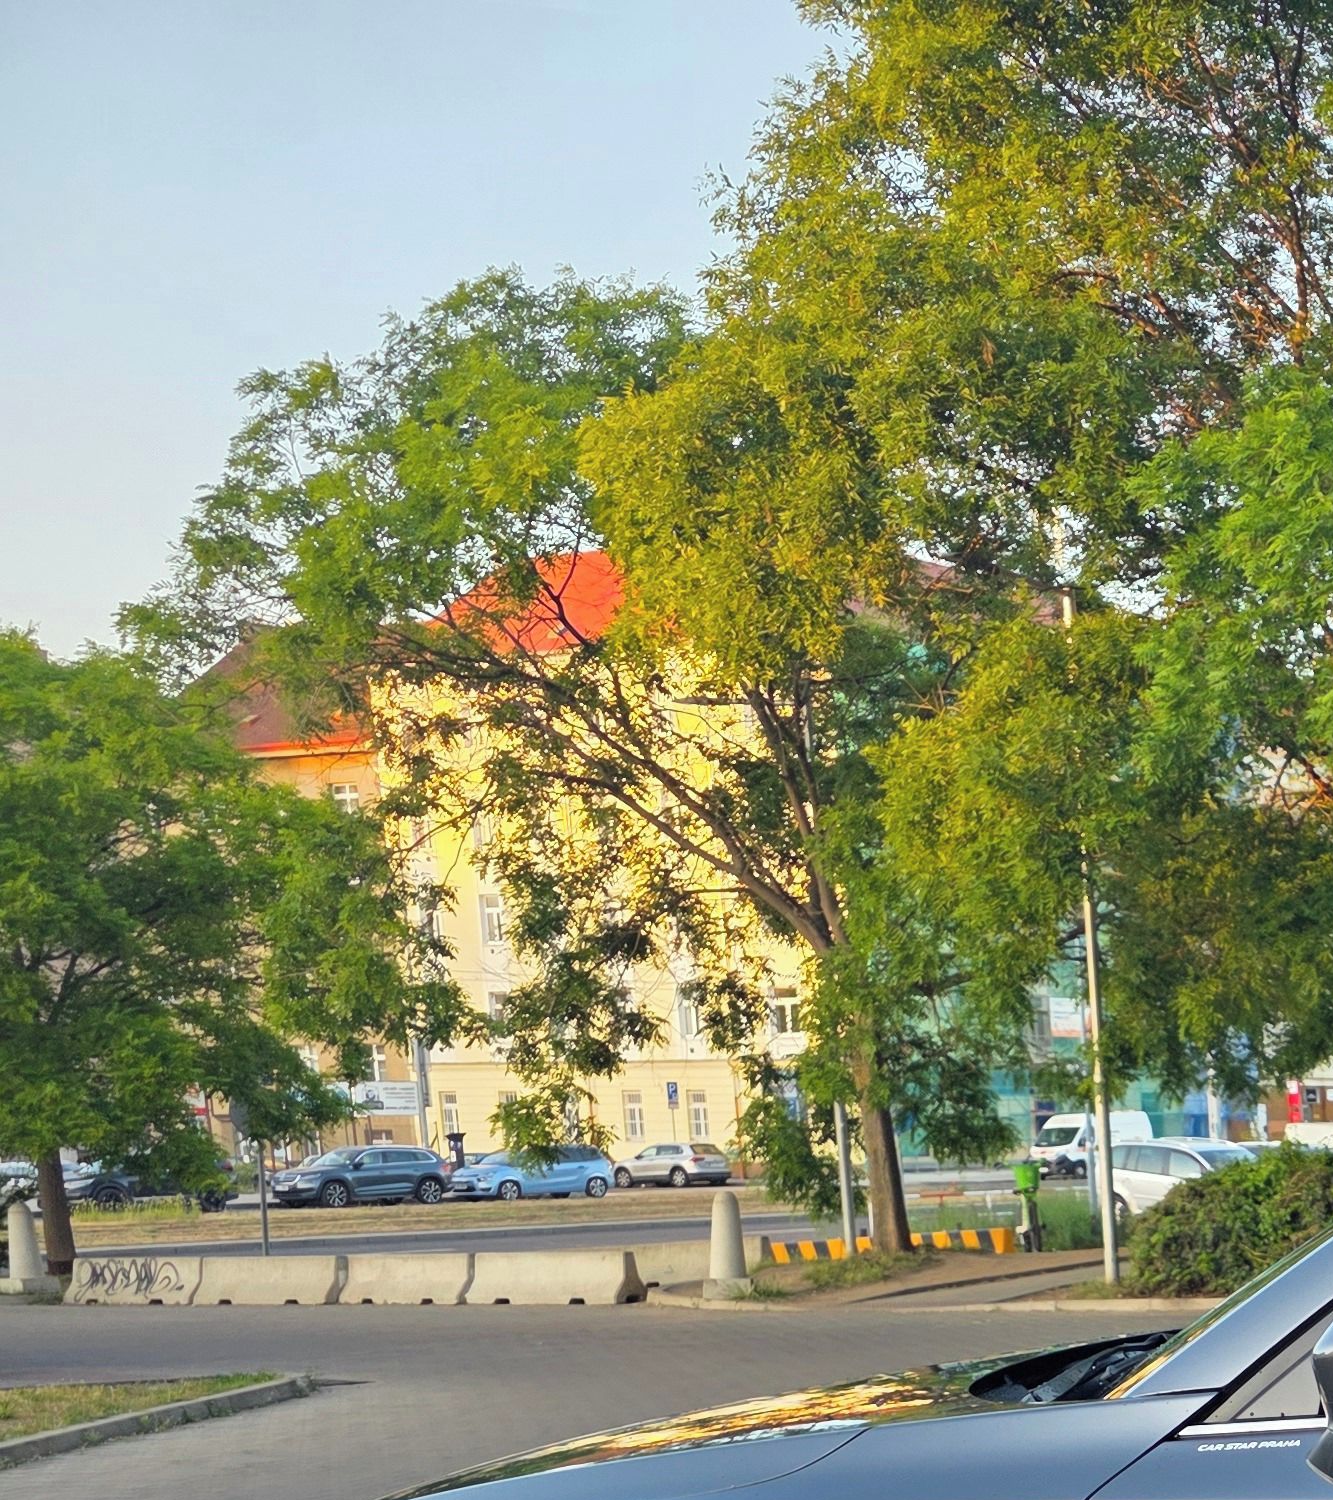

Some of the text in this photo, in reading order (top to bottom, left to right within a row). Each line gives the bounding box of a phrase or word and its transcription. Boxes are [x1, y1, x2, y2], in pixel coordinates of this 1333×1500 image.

[1198, 1440, 1301, 1452] CAR STAR PRAHA
